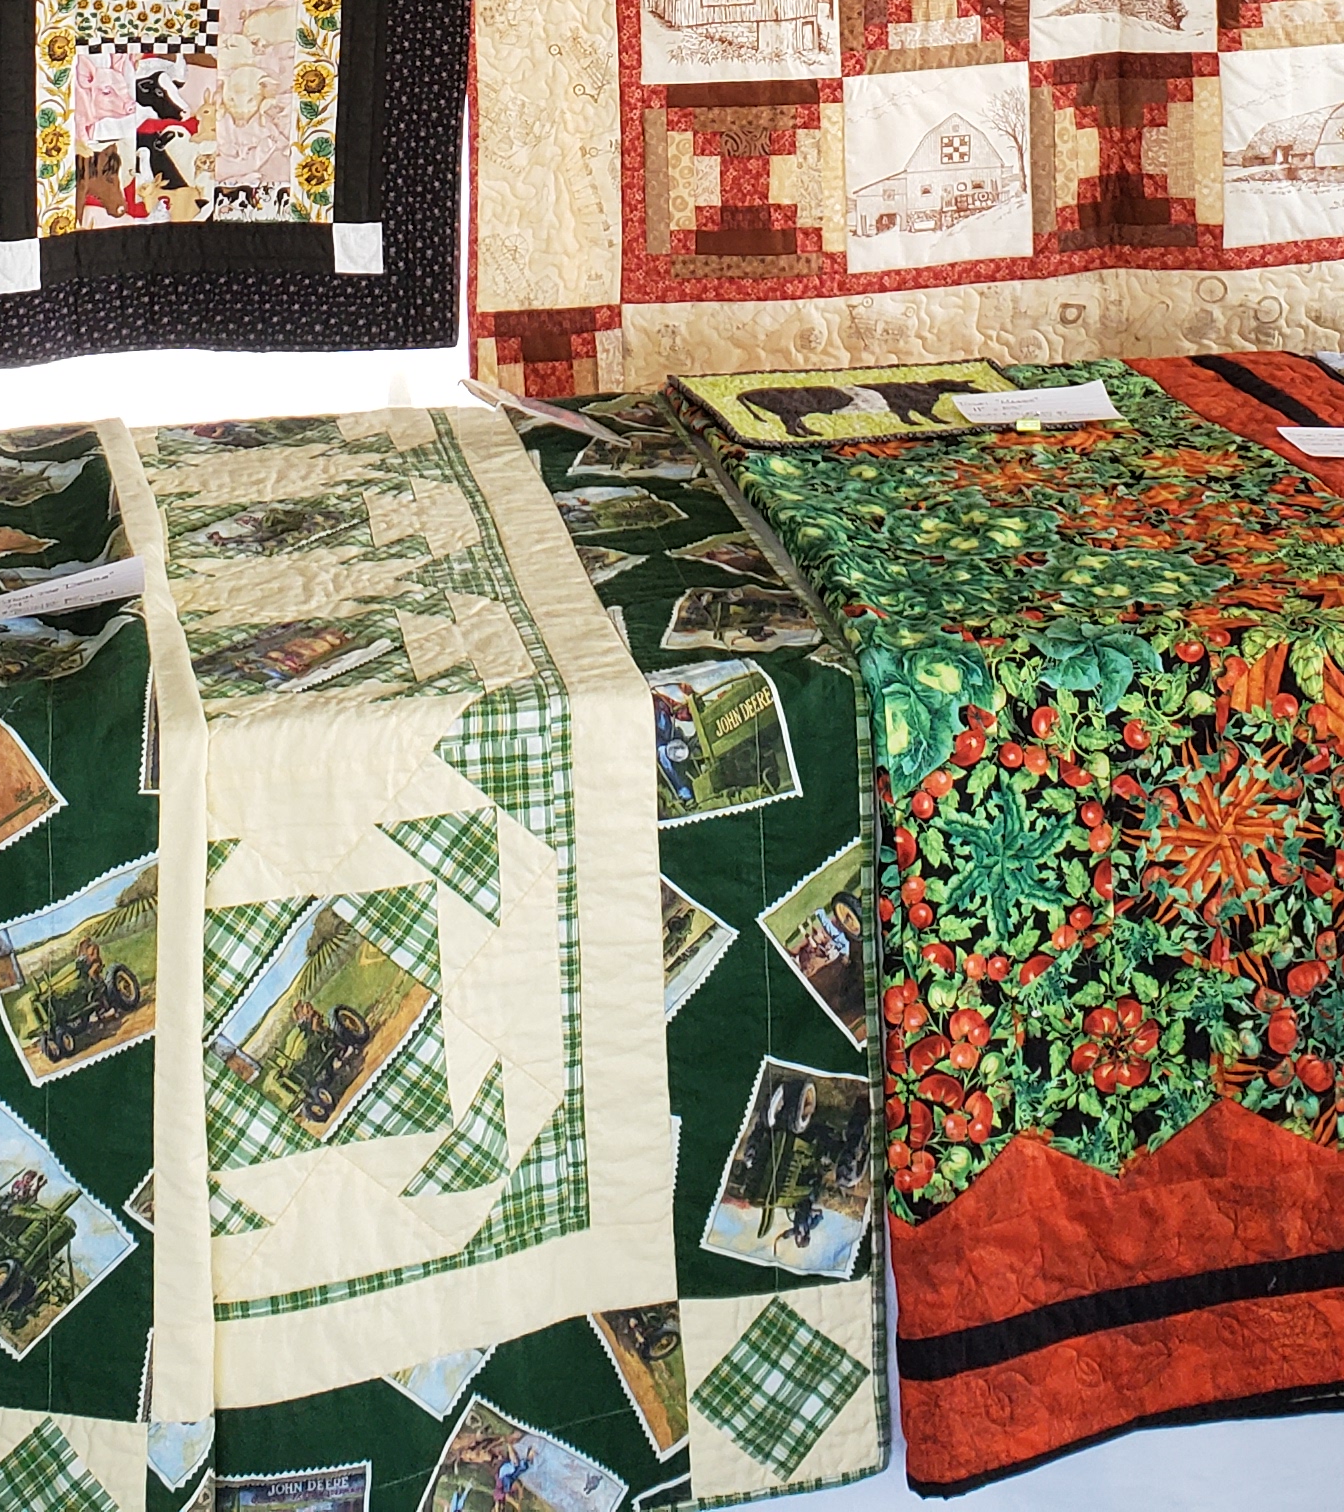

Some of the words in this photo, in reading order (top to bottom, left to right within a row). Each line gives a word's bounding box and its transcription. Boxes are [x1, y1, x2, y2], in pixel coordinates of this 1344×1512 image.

[715, 706, 743, 738] JOHN
[739, 685, 774, 722] DEERE
[267, 1481, 303, 1497] JOHN
[306, 1476, 350, 1492] DEERE
